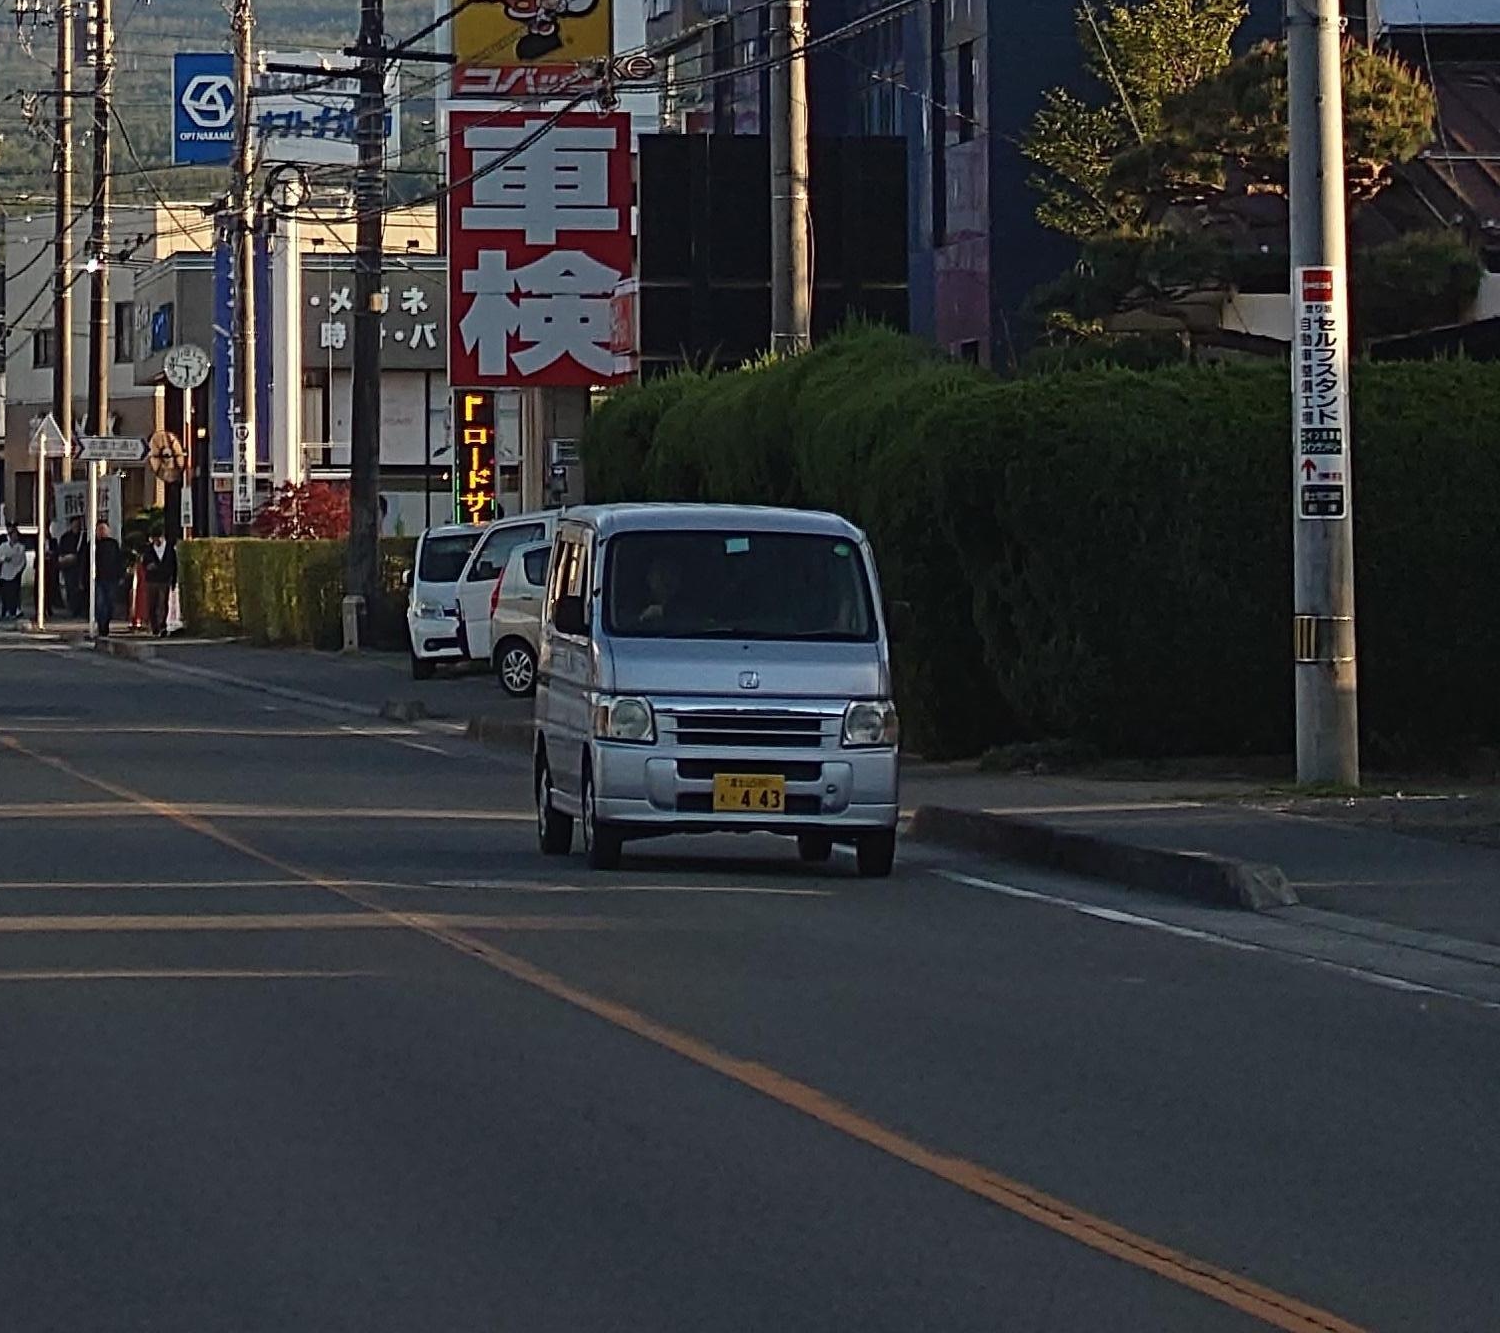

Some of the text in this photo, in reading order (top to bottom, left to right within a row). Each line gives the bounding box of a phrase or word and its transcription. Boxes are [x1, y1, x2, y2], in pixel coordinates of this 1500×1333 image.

[459, 119, 623, 376] 車検
[1313, 316, 1338, 425] セルフスタンド
